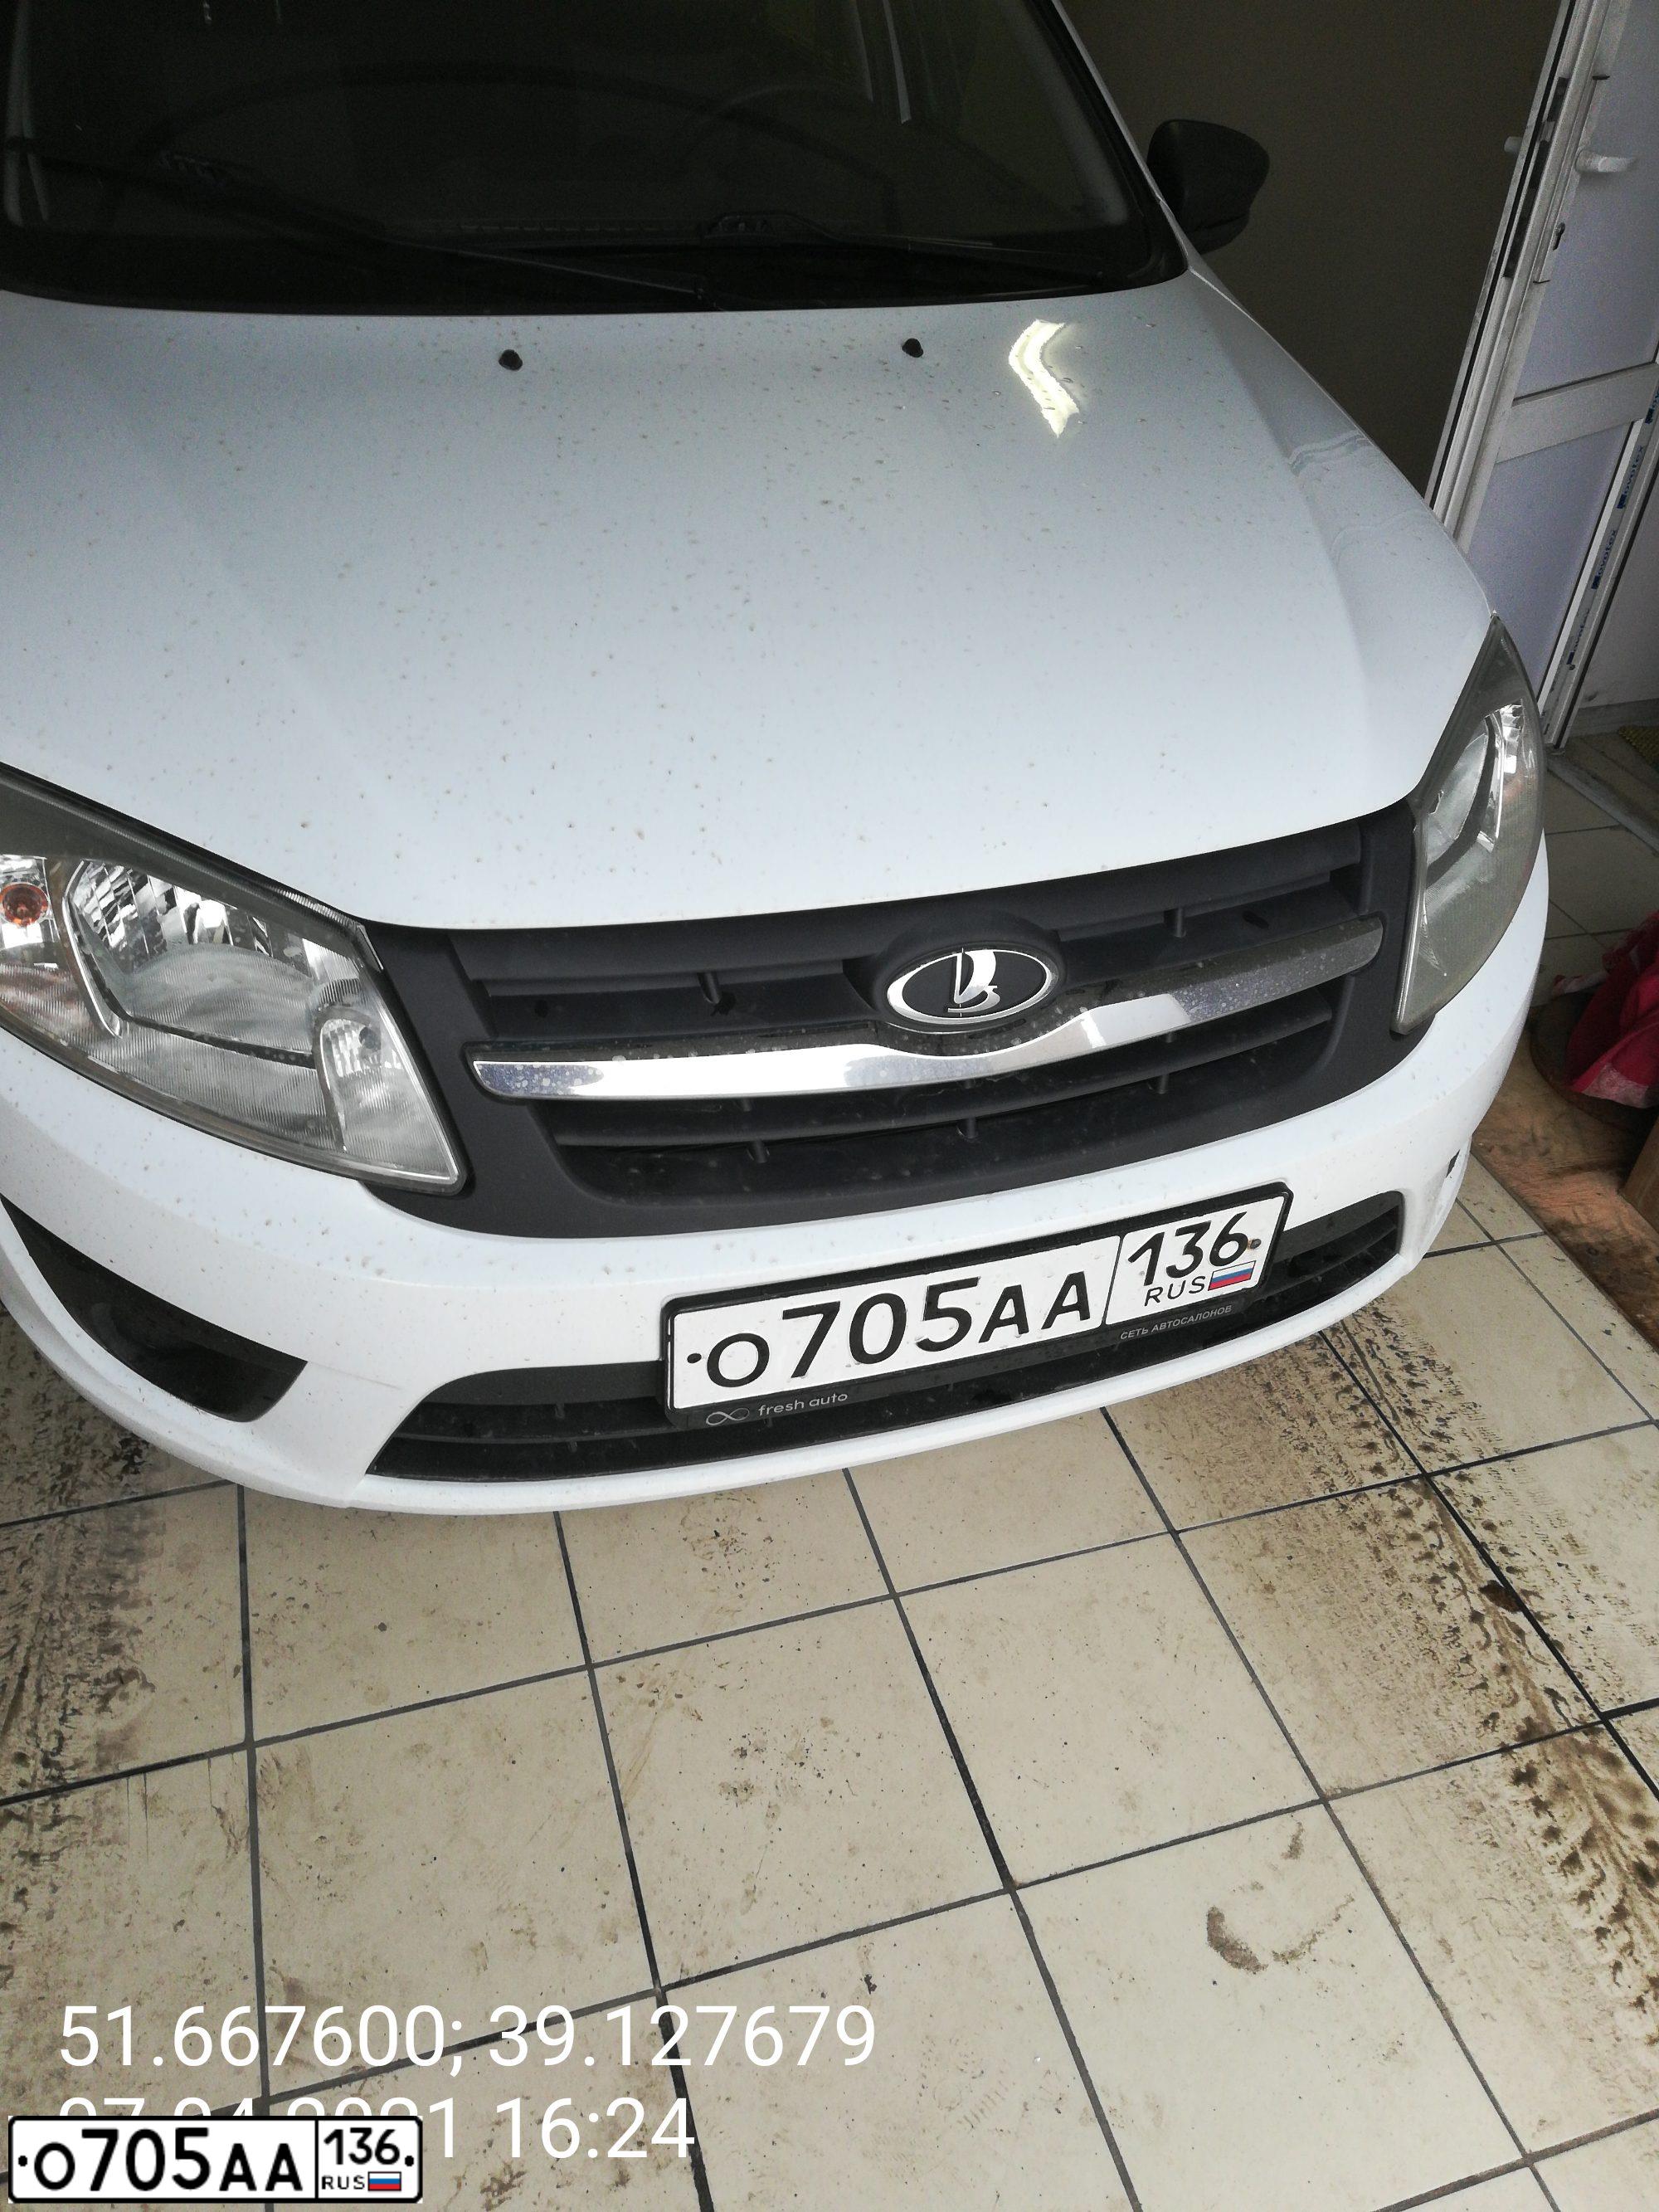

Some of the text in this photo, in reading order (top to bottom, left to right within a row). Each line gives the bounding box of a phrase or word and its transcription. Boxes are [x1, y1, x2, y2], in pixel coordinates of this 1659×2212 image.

[1127, 1211, 1248, 1286] 136
[1145, 1276, 1206, 1307] RUS
[1120, 1304, 1233, 1341] СЕТЬ АВТОСАЛОНОВ
[758, 1392, 848, 1416] fresh auto
